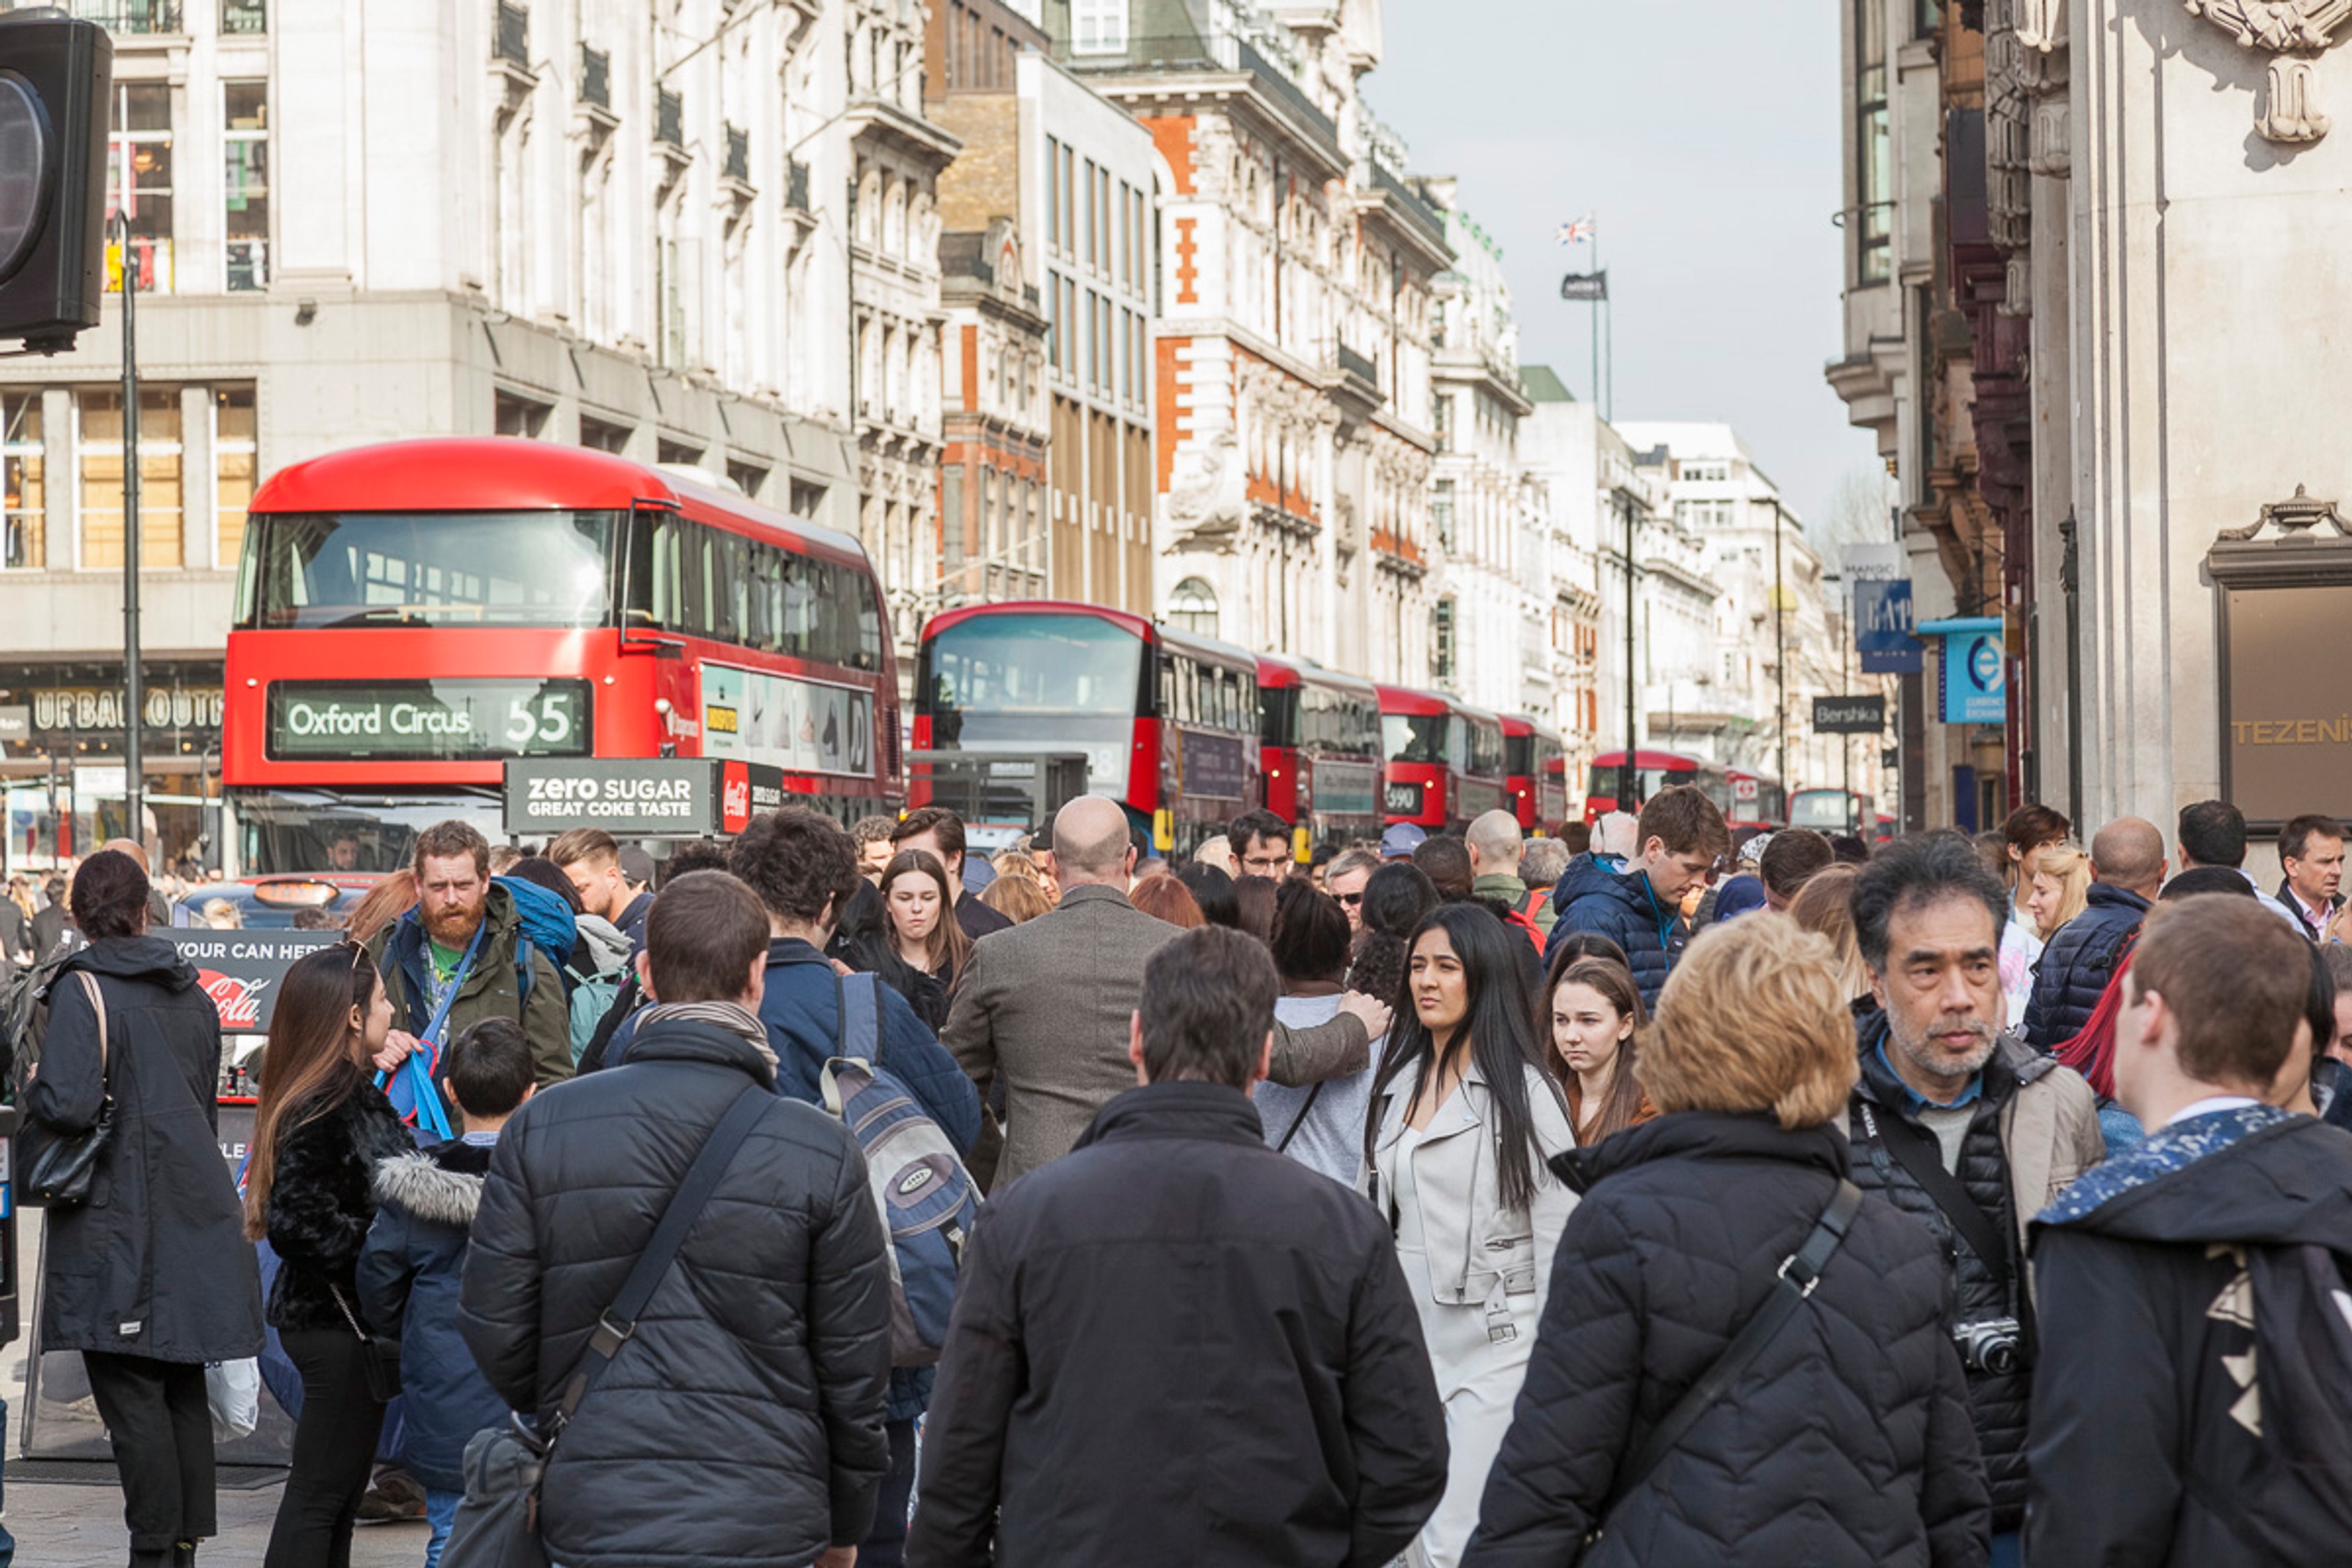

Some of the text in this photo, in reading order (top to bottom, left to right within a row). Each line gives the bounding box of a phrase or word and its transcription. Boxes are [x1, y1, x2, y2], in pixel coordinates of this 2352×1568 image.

[289, 703, 471, 735] Oxford Circus
[506, 694, 571, 743] 55
[1816, 705, 1880, 723] Bershka
[528, 777, 691, 800] zero SUGAR
[528, 802, 691, 817] GREAT COKE TASTE
[175, 942, 331, 960] YOUR CAN HER
[217, 1143, 245, 1159] LE
